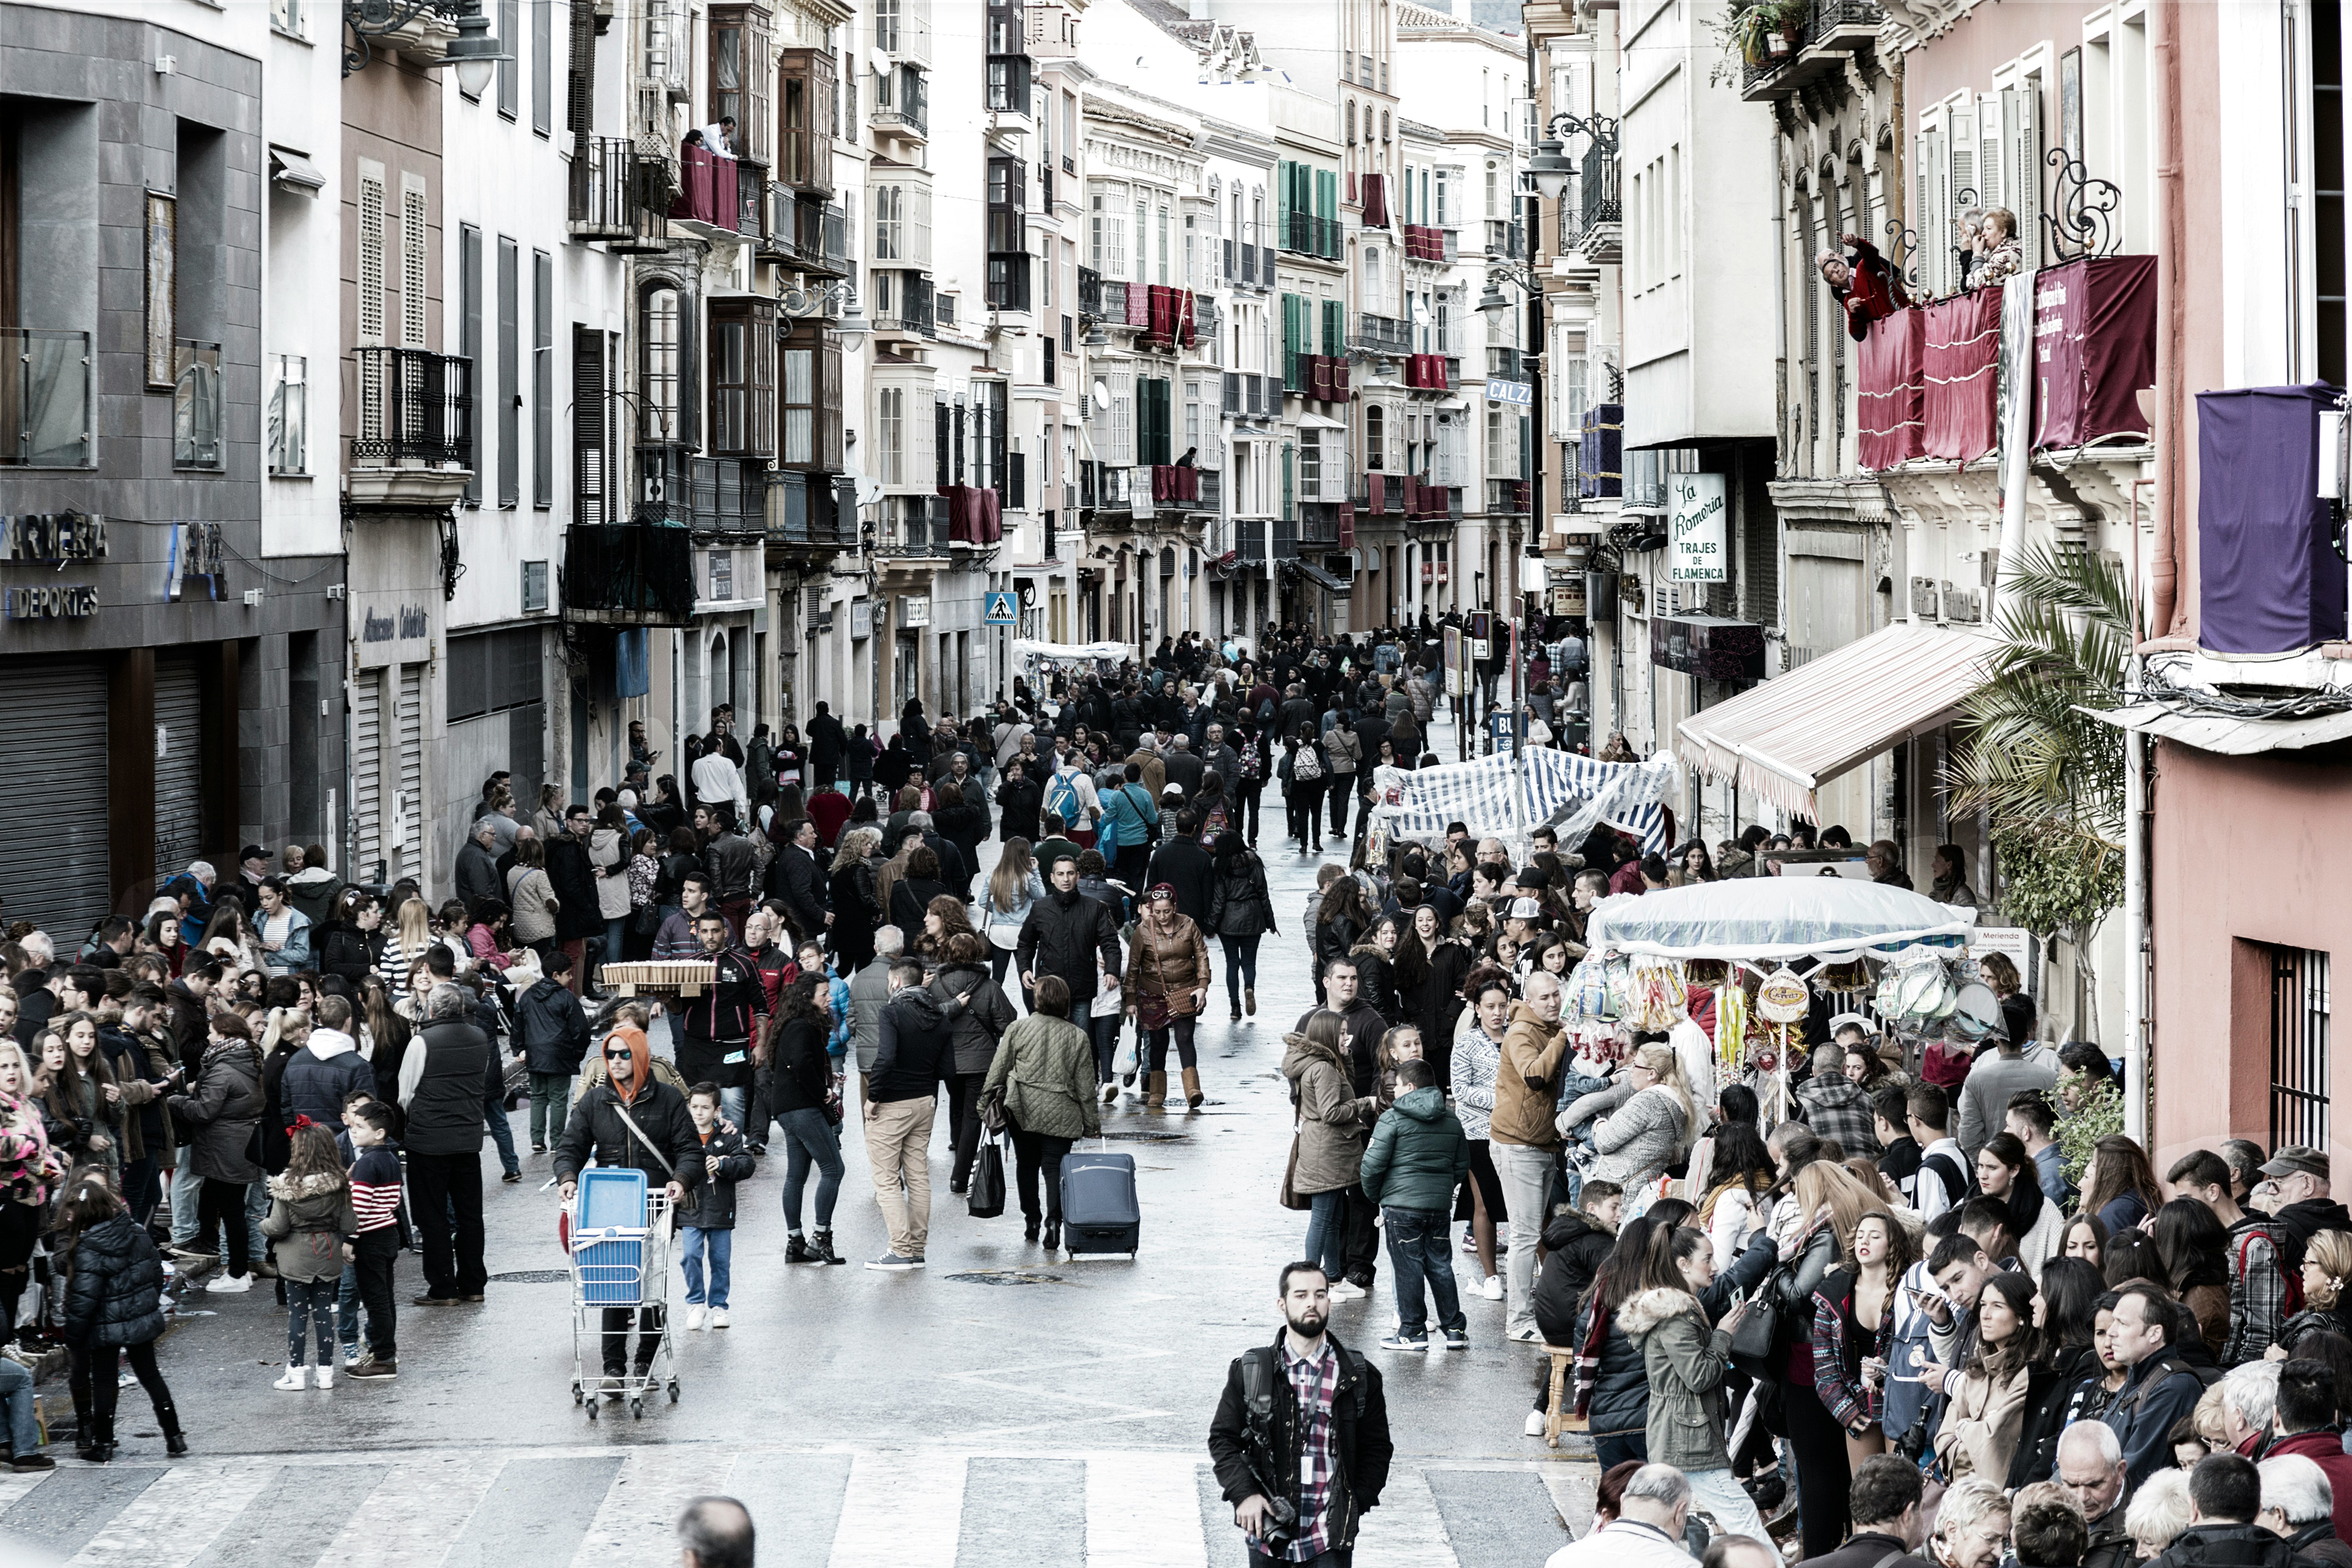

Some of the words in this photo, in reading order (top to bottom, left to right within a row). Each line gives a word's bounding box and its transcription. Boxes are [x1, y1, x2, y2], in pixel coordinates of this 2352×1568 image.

[1676, 477, 1697, 508] La
[1679, 543, 1716, 553] TRAJES
[1693, 557, 1702, 565] DE
[1673, 568, 1723, 579] FLAMENCA
[11, 586, 98, 617] DEPORTES
[1499, 717, 1512, 734] BU
